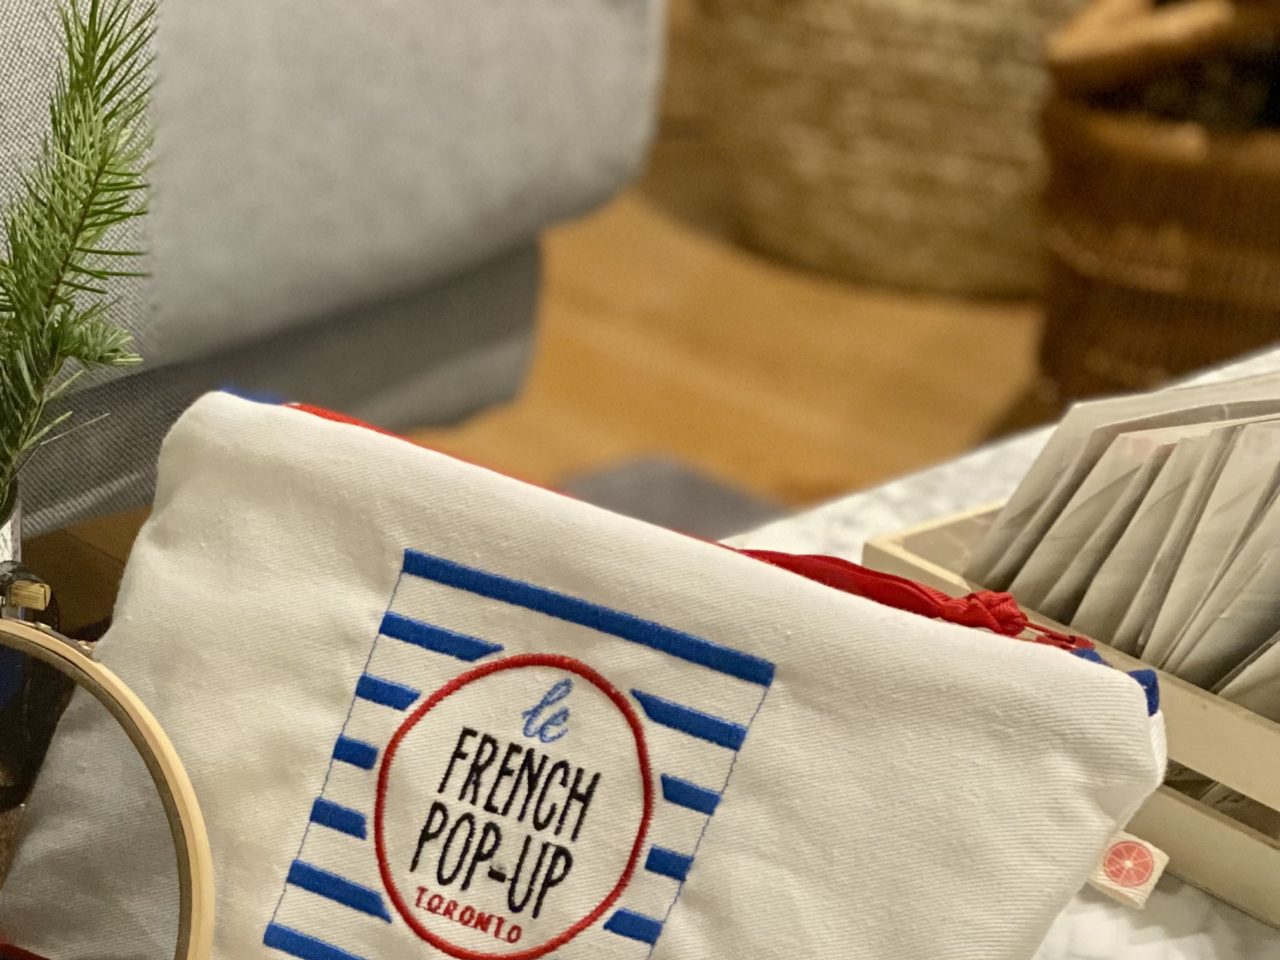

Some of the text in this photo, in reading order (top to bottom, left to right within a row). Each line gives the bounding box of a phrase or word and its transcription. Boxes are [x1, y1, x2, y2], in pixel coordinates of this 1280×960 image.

[521, 678, 574, 743] le
[437, 727, 601, 842] FRENCH
[410, 801, 573, 919] POP-UP
[415, 886, 523, 944] TORONTO
